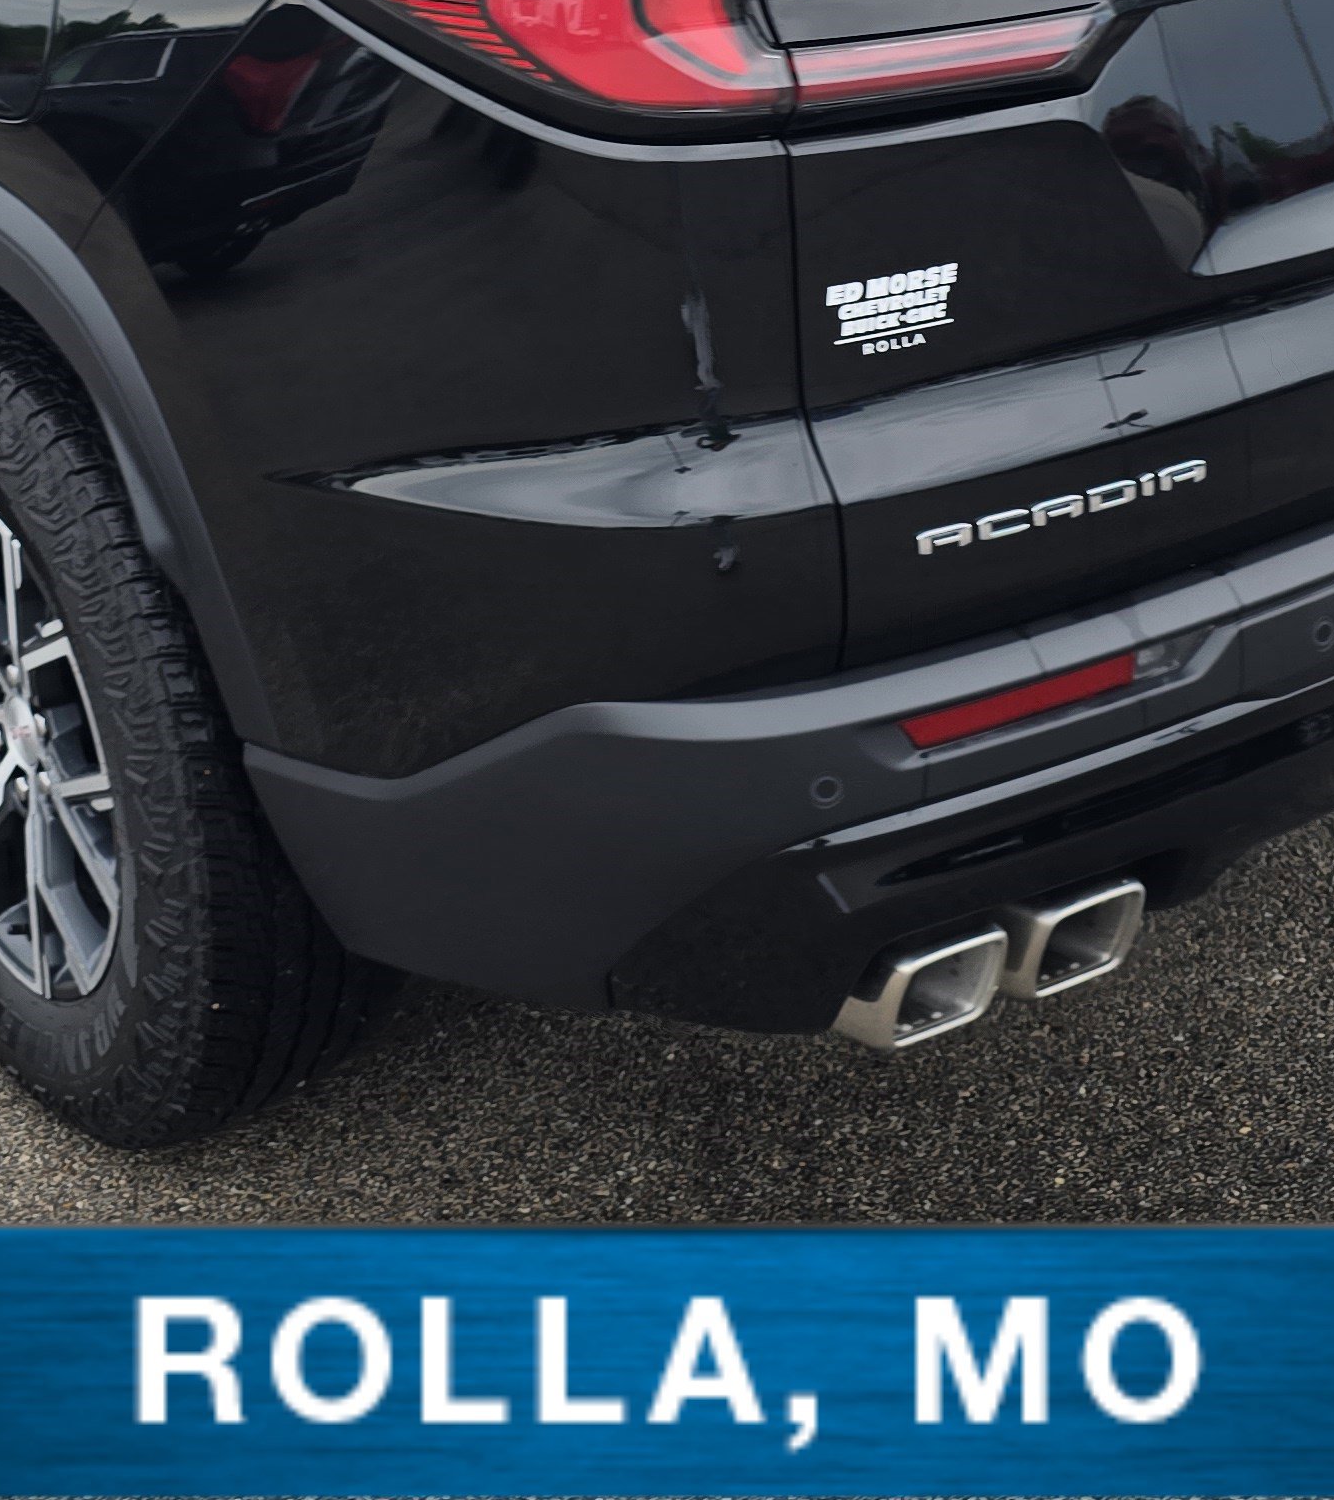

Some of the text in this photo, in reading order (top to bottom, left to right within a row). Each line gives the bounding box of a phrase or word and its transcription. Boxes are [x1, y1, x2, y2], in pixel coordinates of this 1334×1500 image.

[825, 262, 959, 307] ED MORSE
[837, 285, 951, 321] CHEVROLET
[861, 333, 927, 356] ROLLA
[916, 459, 1207, 555] ACADIA
